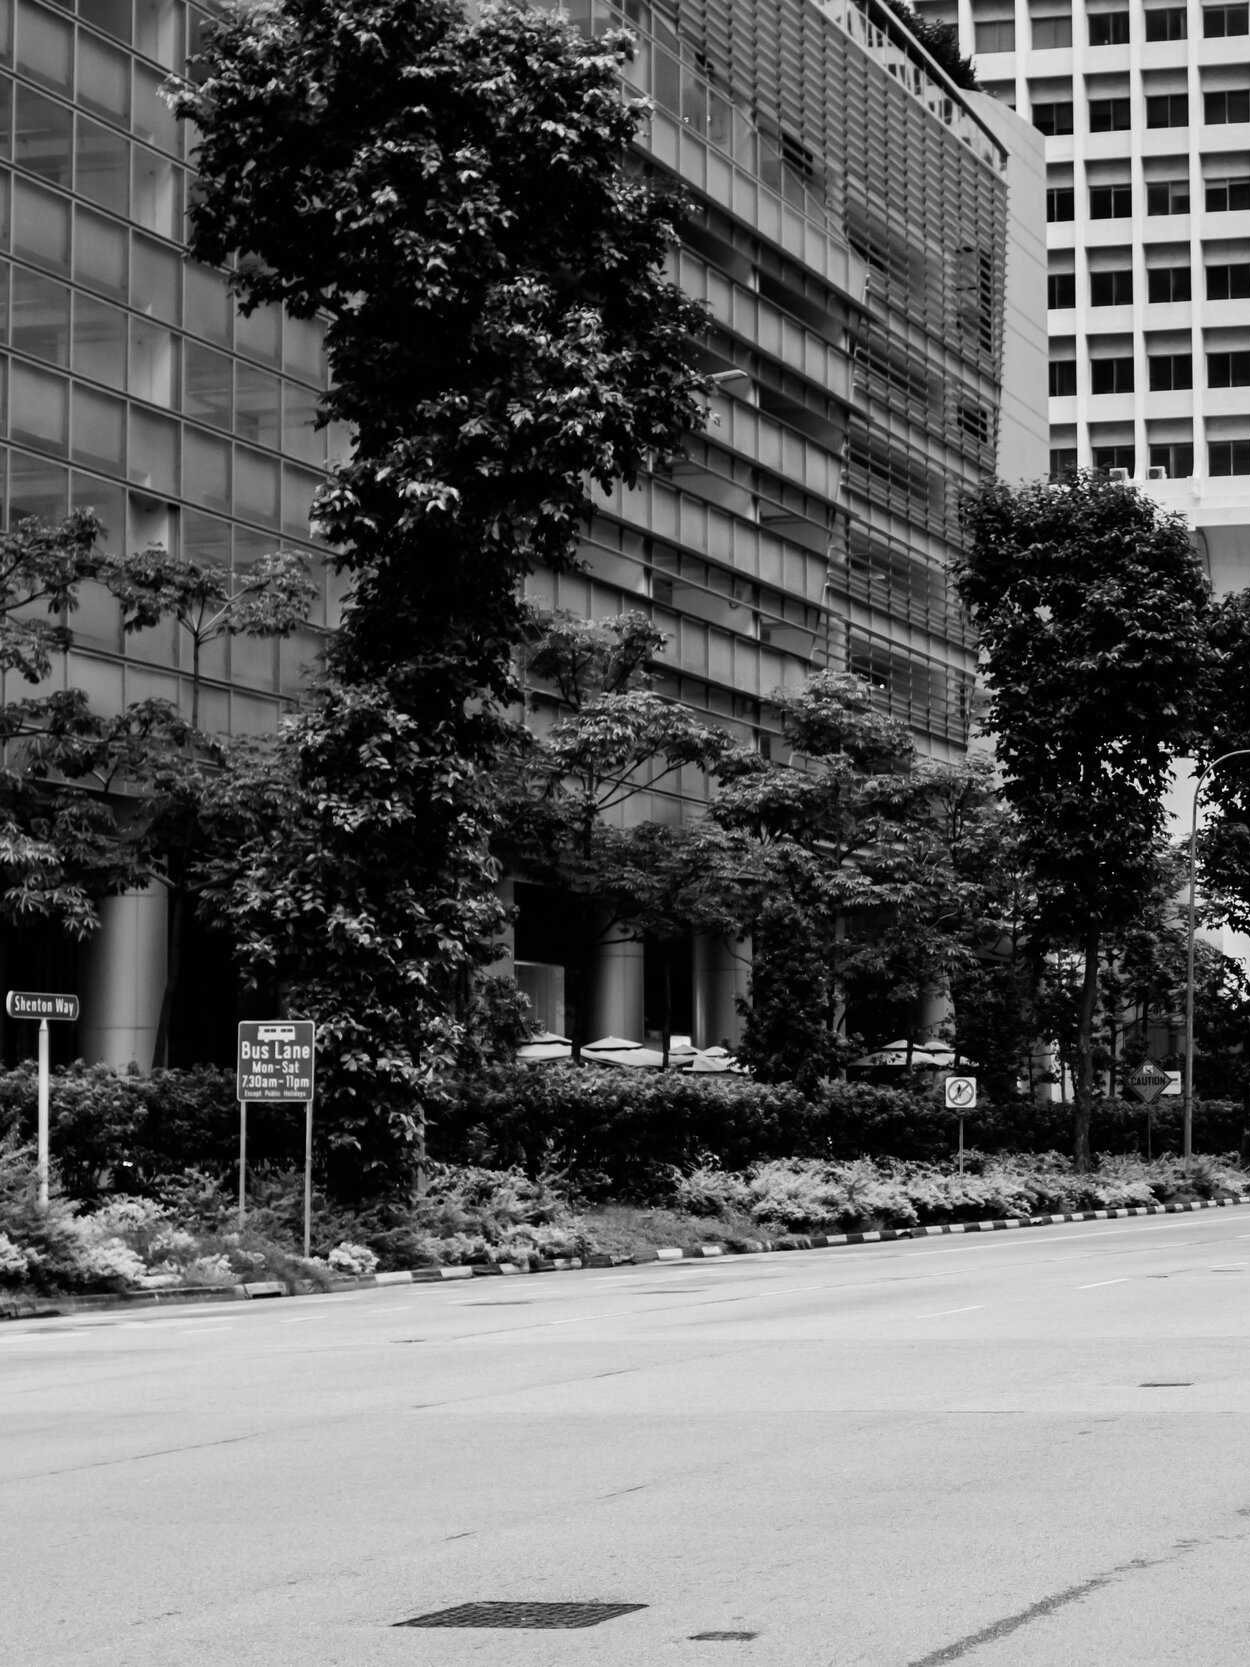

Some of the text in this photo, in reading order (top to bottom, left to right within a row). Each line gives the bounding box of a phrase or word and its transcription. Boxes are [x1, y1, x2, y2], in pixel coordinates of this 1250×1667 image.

[14, 995, 74, 1017] Shenton Way
[241, 1041, 310, 1059] Bus Lane
[1130, 1076, 1166, 1086] CAUTION
